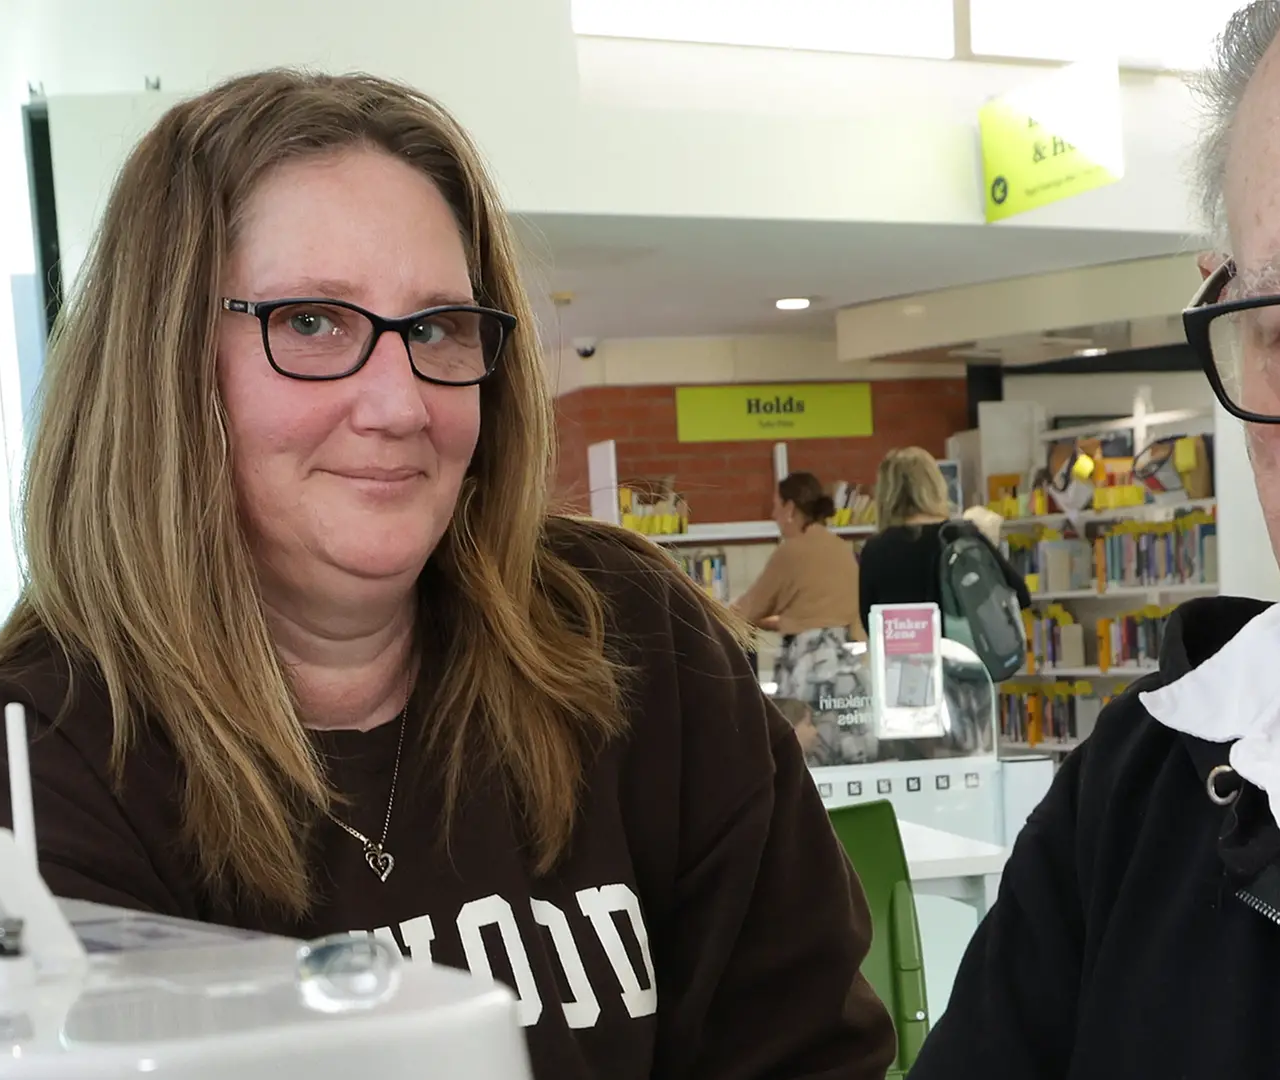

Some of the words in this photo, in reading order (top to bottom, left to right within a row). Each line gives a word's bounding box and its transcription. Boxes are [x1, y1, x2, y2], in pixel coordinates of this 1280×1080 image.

[746, 396, 805, 414] Holds
[884, 618, 928, 631] Tinker
[884, 630, 916, 640] Zone
